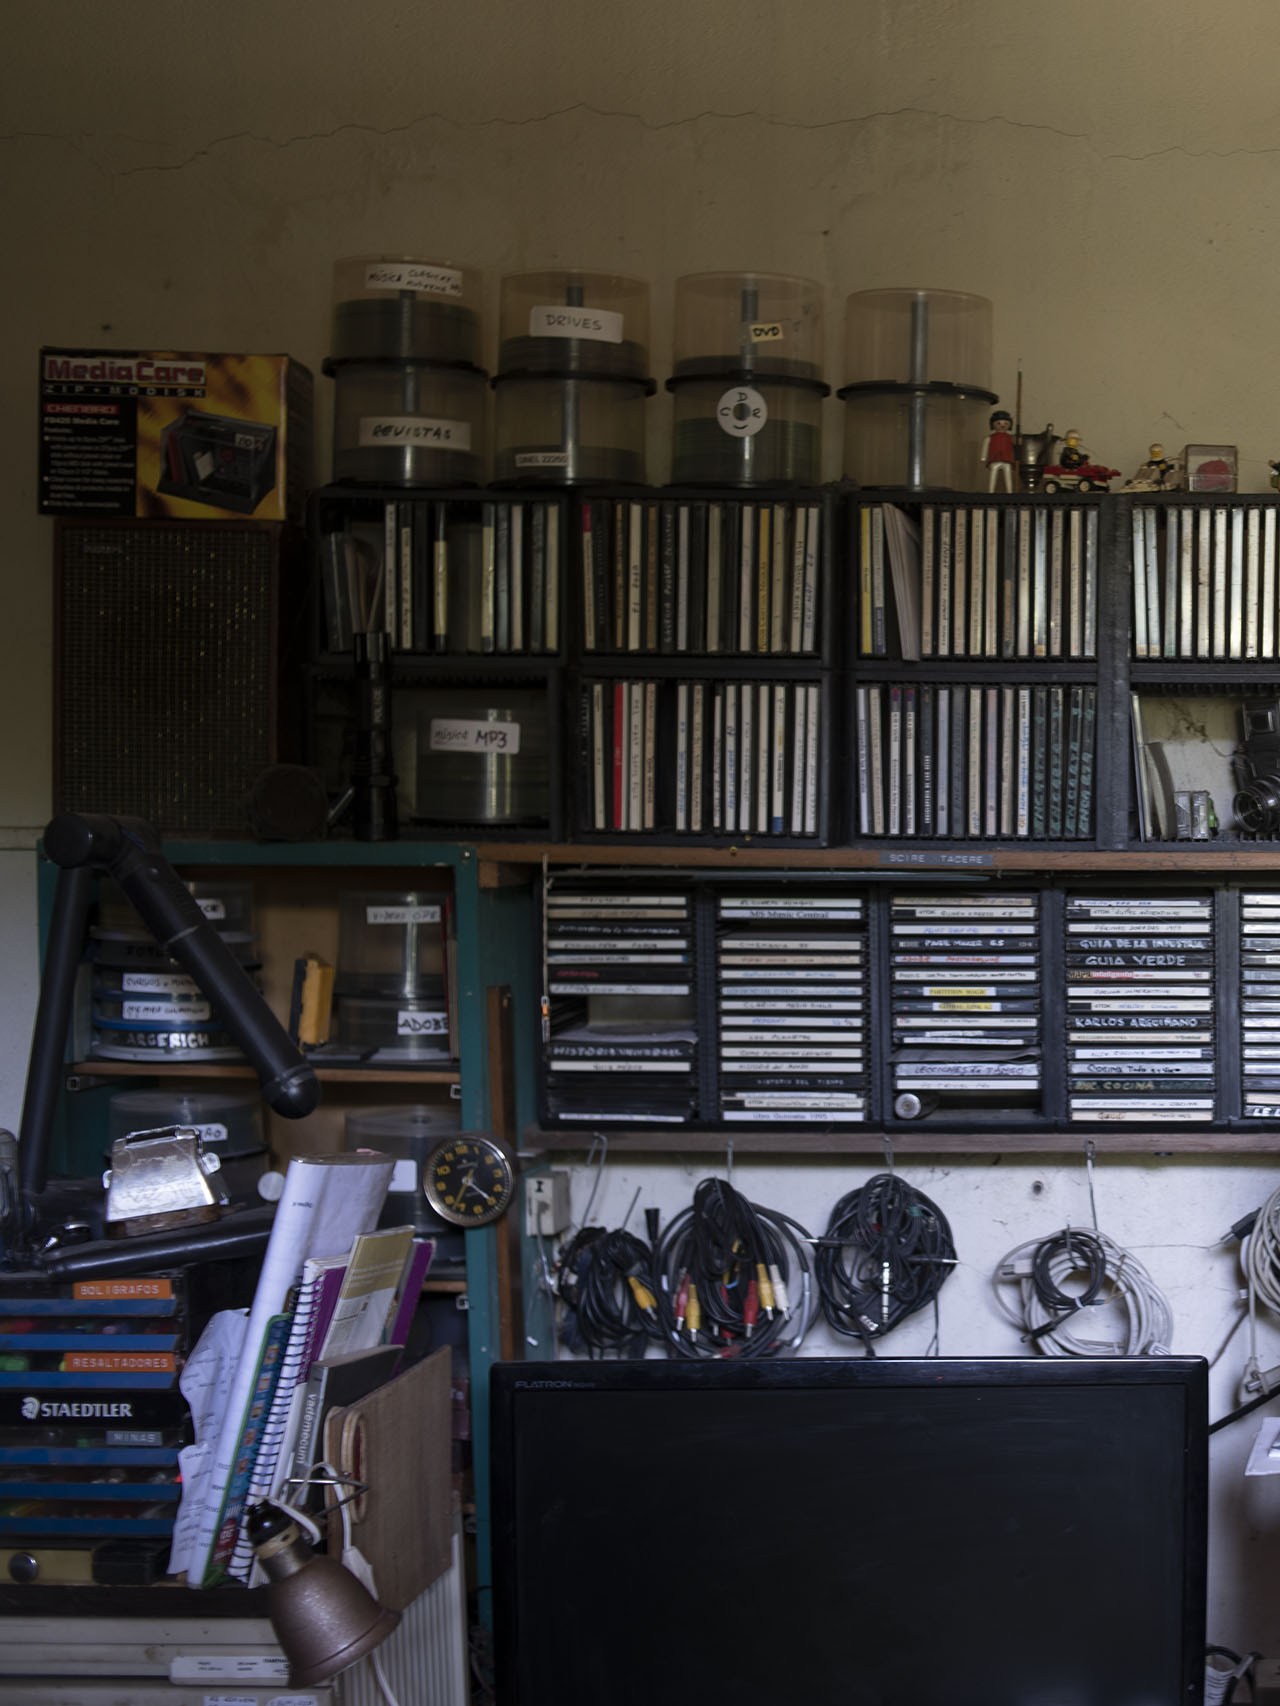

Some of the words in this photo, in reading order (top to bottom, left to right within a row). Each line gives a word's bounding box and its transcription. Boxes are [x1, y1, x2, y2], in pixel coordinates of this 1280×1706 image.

[545, 313, 603, 331] DRIVES
[752, 326, 780, 337] DVD
[475, 729, 508, 748] MP3
[889, 853, 925, 863] SCIRE
[940, 854, 984, 864] TACERE
[768, 910, 792, 919] Music
[796, 910, 829, 919] Central
[1085, 955, 1126, 967] GUIA
[1132, 955, 1187, 967] VERDE
[398, 1016, 449, 1032] ADOBE
[1075, 1017, 1125, 1028] KARLOS
[1253, 1107, 1272, 1118] LE
[80, 1284, 160, 1298] BOLIGRAFOS
[72, 1357, 169, 1369] RESALTADORES
[514, 1380, 573, 1389] FLATRON
[42, 1402, 133, 1418] STAEDTLER
[296, 1394, 317, 1464] vademecum
